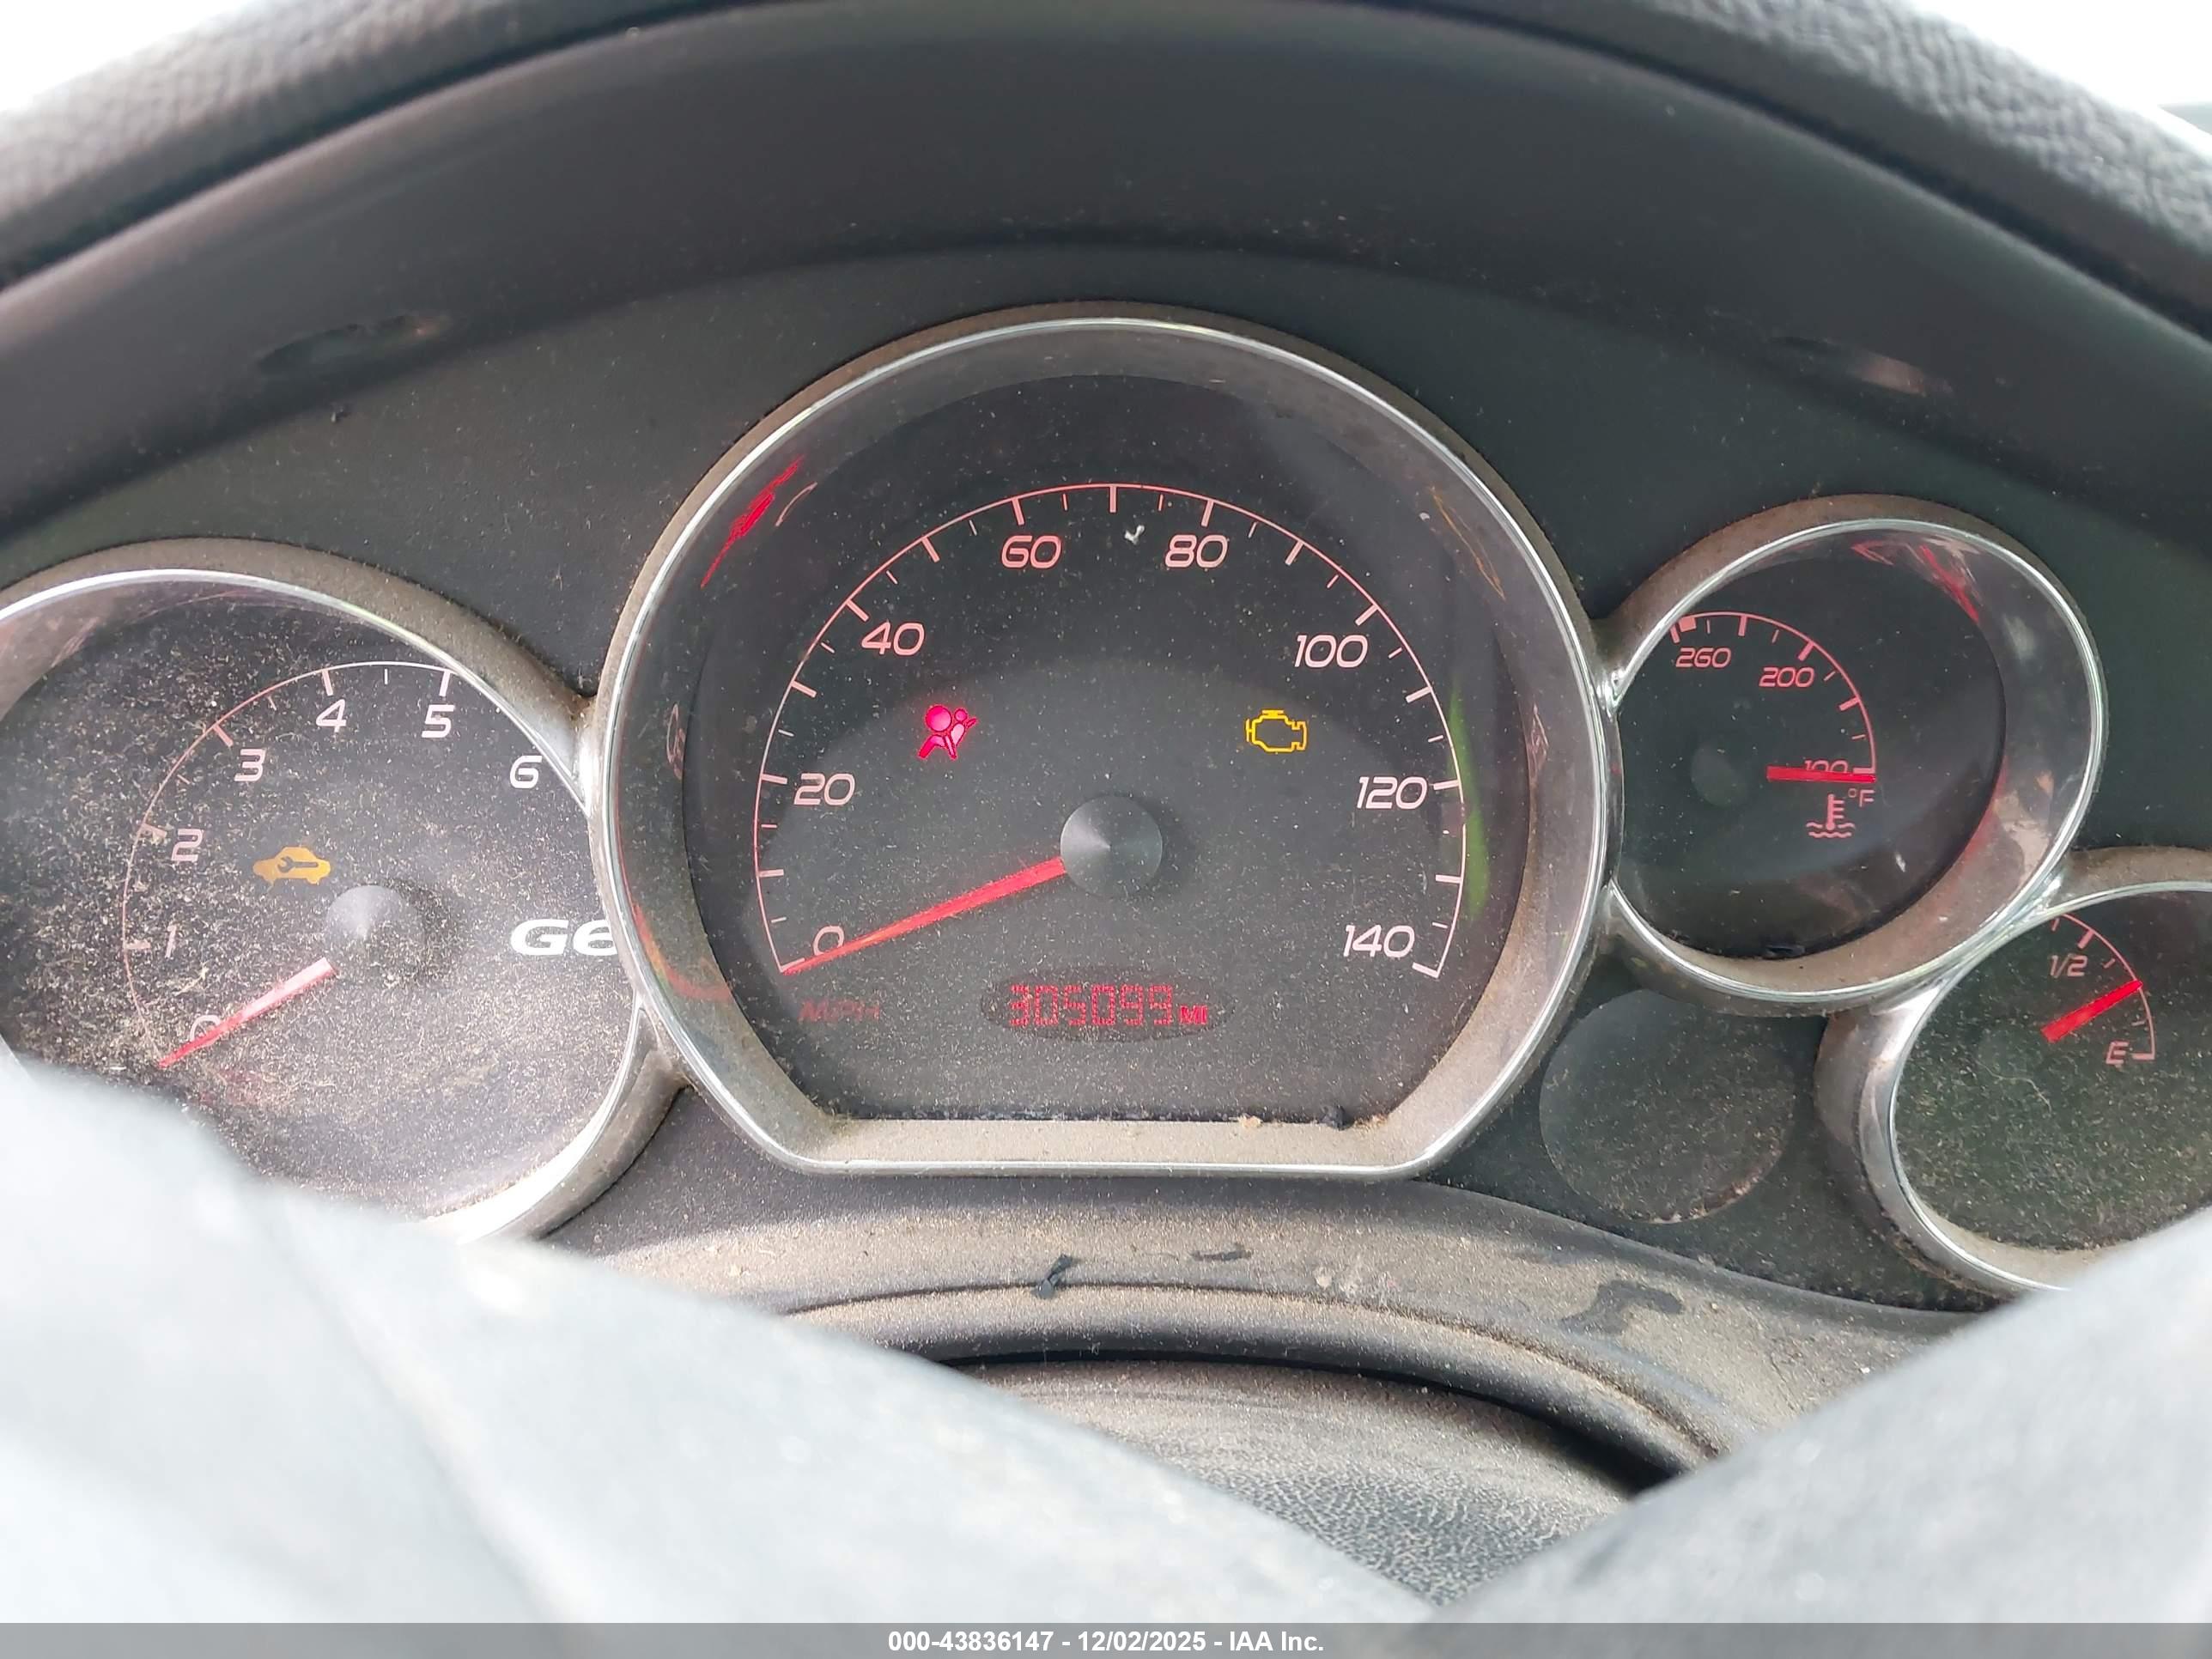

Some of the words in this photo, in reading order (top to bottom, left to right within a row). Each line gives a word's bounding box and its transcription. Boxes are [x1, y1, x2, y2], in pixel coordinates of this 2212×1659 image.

[1001, 535, 1062, 568] 60
[1164, 534, 1228, 568] 80
[861, 622, 925, 655] 40
[1294, 635, 1368, 667] 100
[1675, 648, 1731, 667] 260
[1759, 667, 1814, 687] 200
[316, 700, 347, 732] 4
[422, 704, 454, 738] 5
[234, 749, 266, 781] 3
[509, 755, 542, 788] 6
[793, 773, 855, 805] 20
[1357, 776, 1427, 810] 120
[171, 828, 204, 861] 2
[165, 925, 178, 957] 1
[510, 919, 617, 956] G6
[813, 926, 845, 956] 0
[1343, 925, 1415, 957] 140
[2050, 953, 2087, 979] 1/2
[1008, 985, 1172, 1026] 305099
[1178, 1005, 1208, 1024] MI
[2106, 1041, 2129, 1065] E
